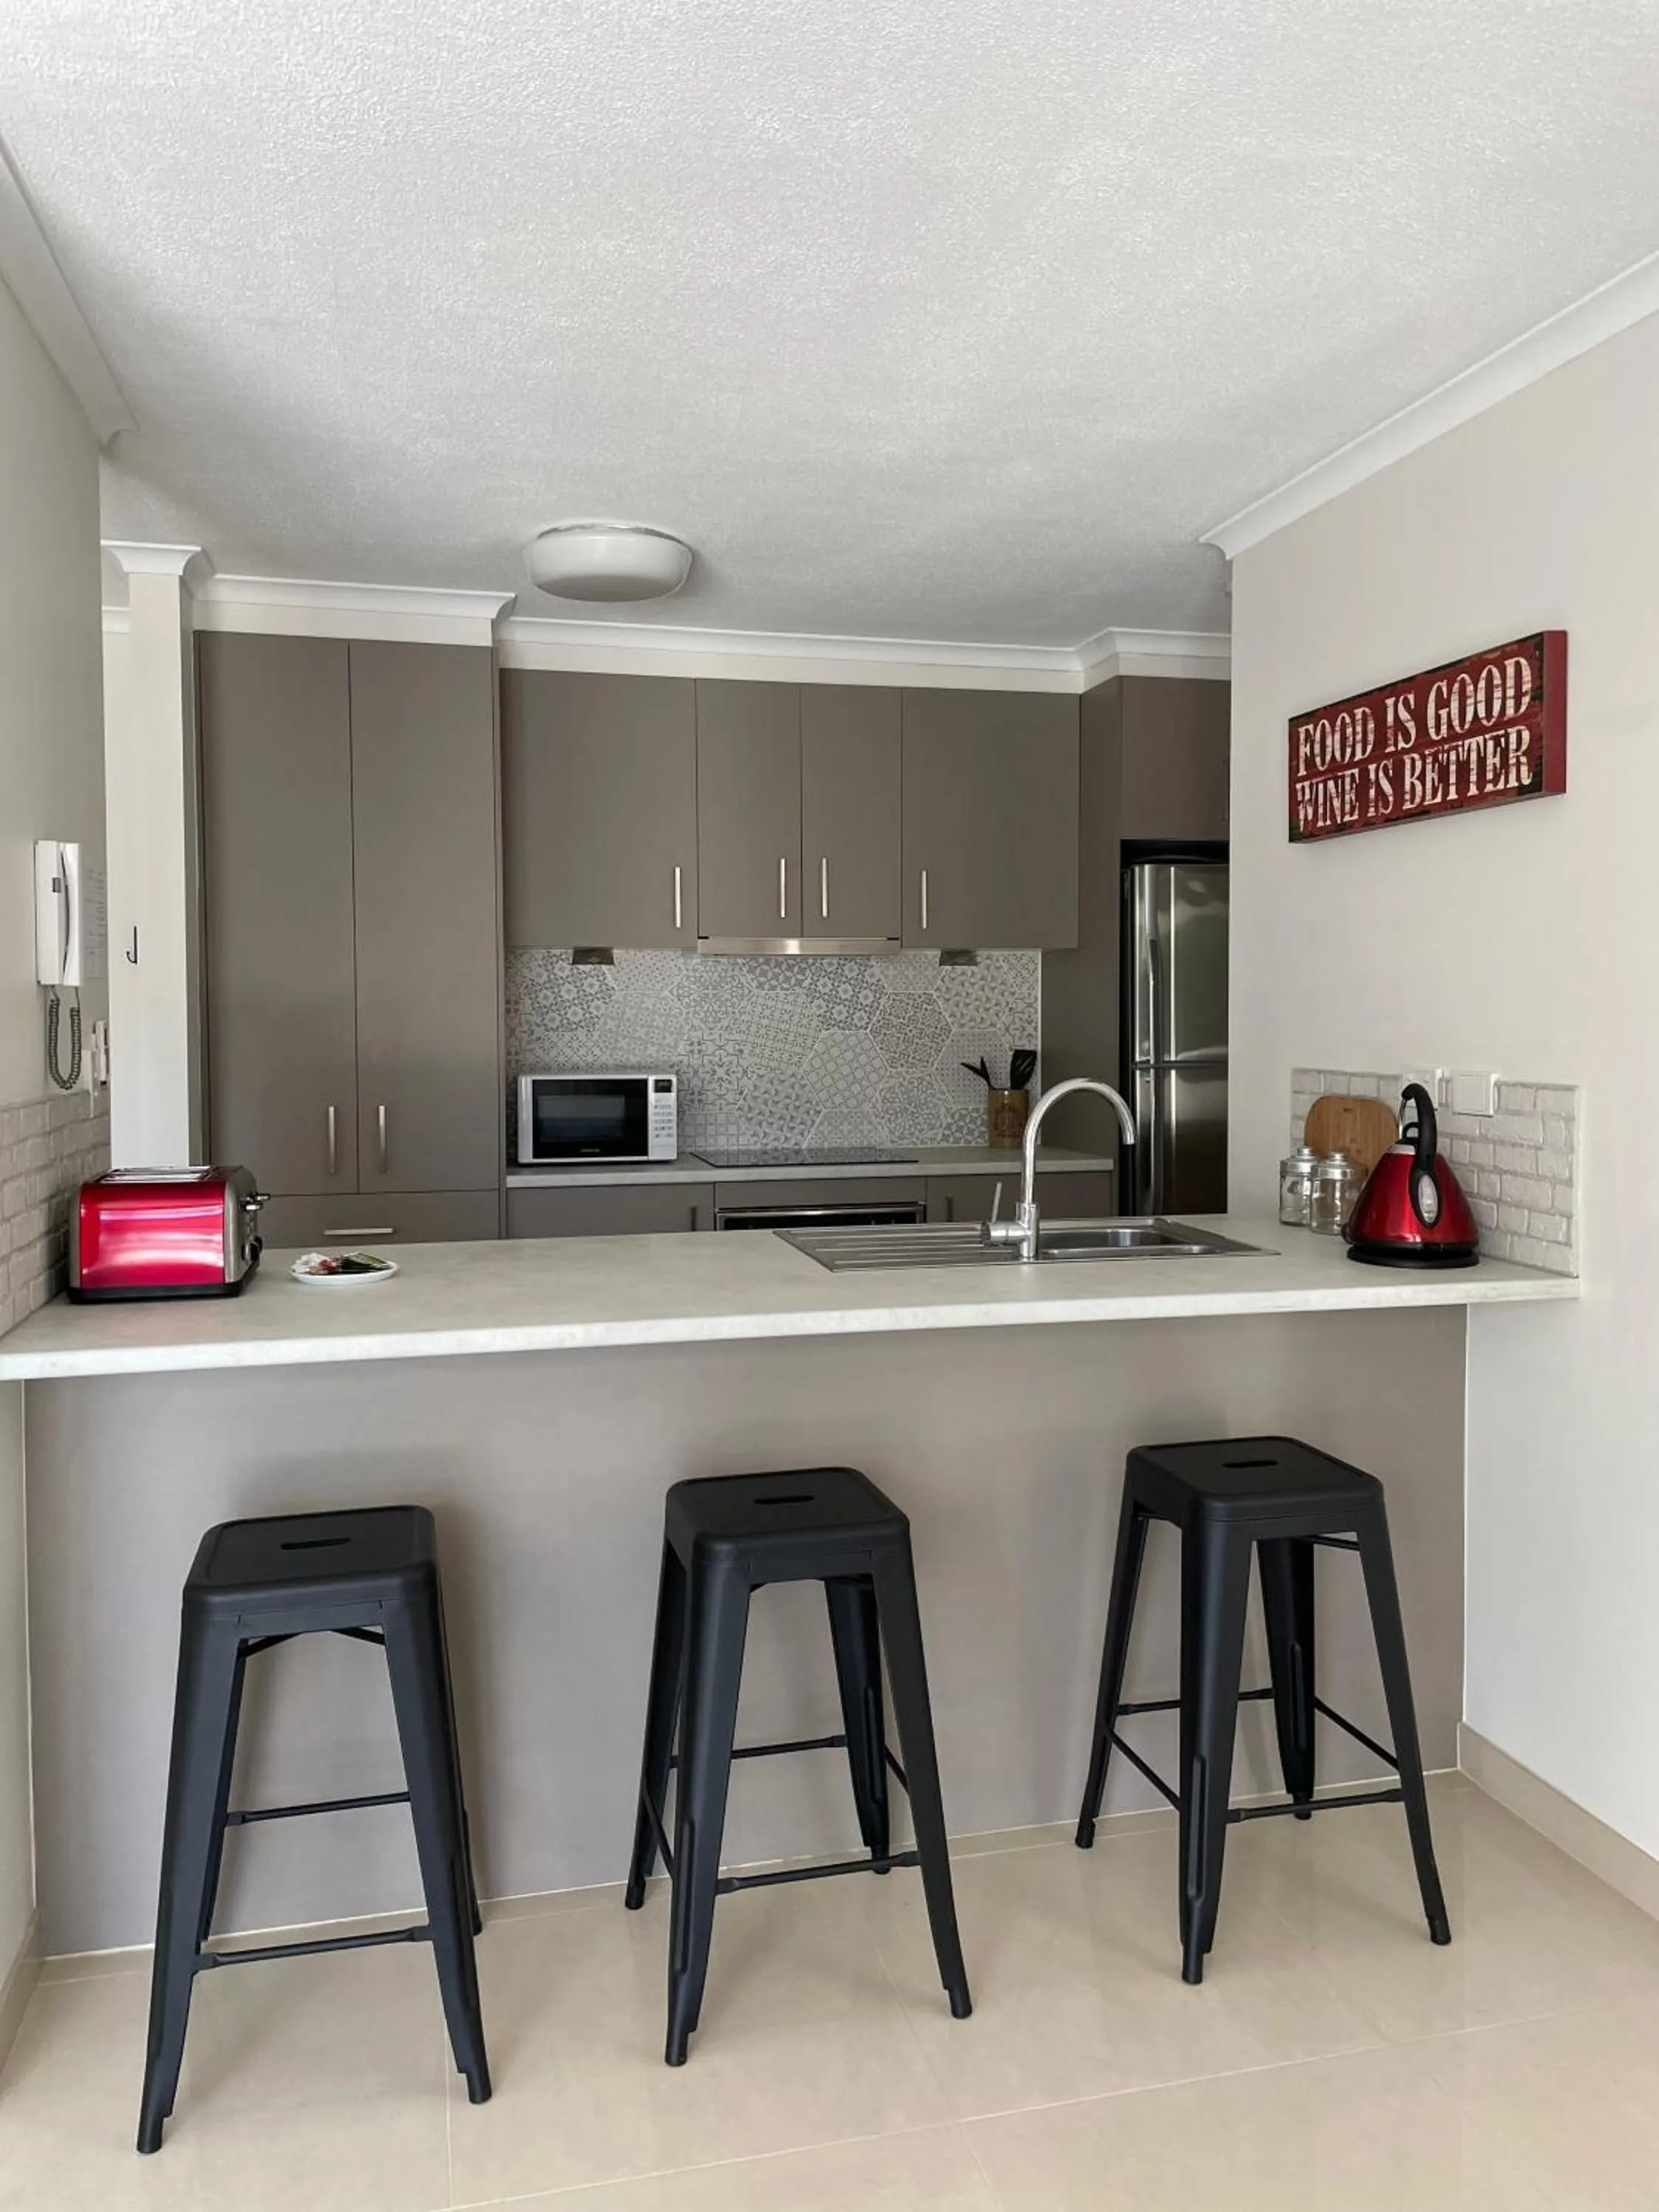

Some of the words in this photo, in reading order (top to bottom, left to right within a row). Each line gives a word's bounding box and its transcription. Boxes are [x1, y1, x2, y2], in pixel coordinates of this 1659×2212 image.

[1297, 706, 1375, 776] FOOD
[1385, 692, 1416, 753] IS
[1427, 656, 1532, 740] GOOD
[1295, 768, 1359, 832] WINE
[1367, 759, 1394, 816] IS
[1402, 725, 1533, 810] BETTER
